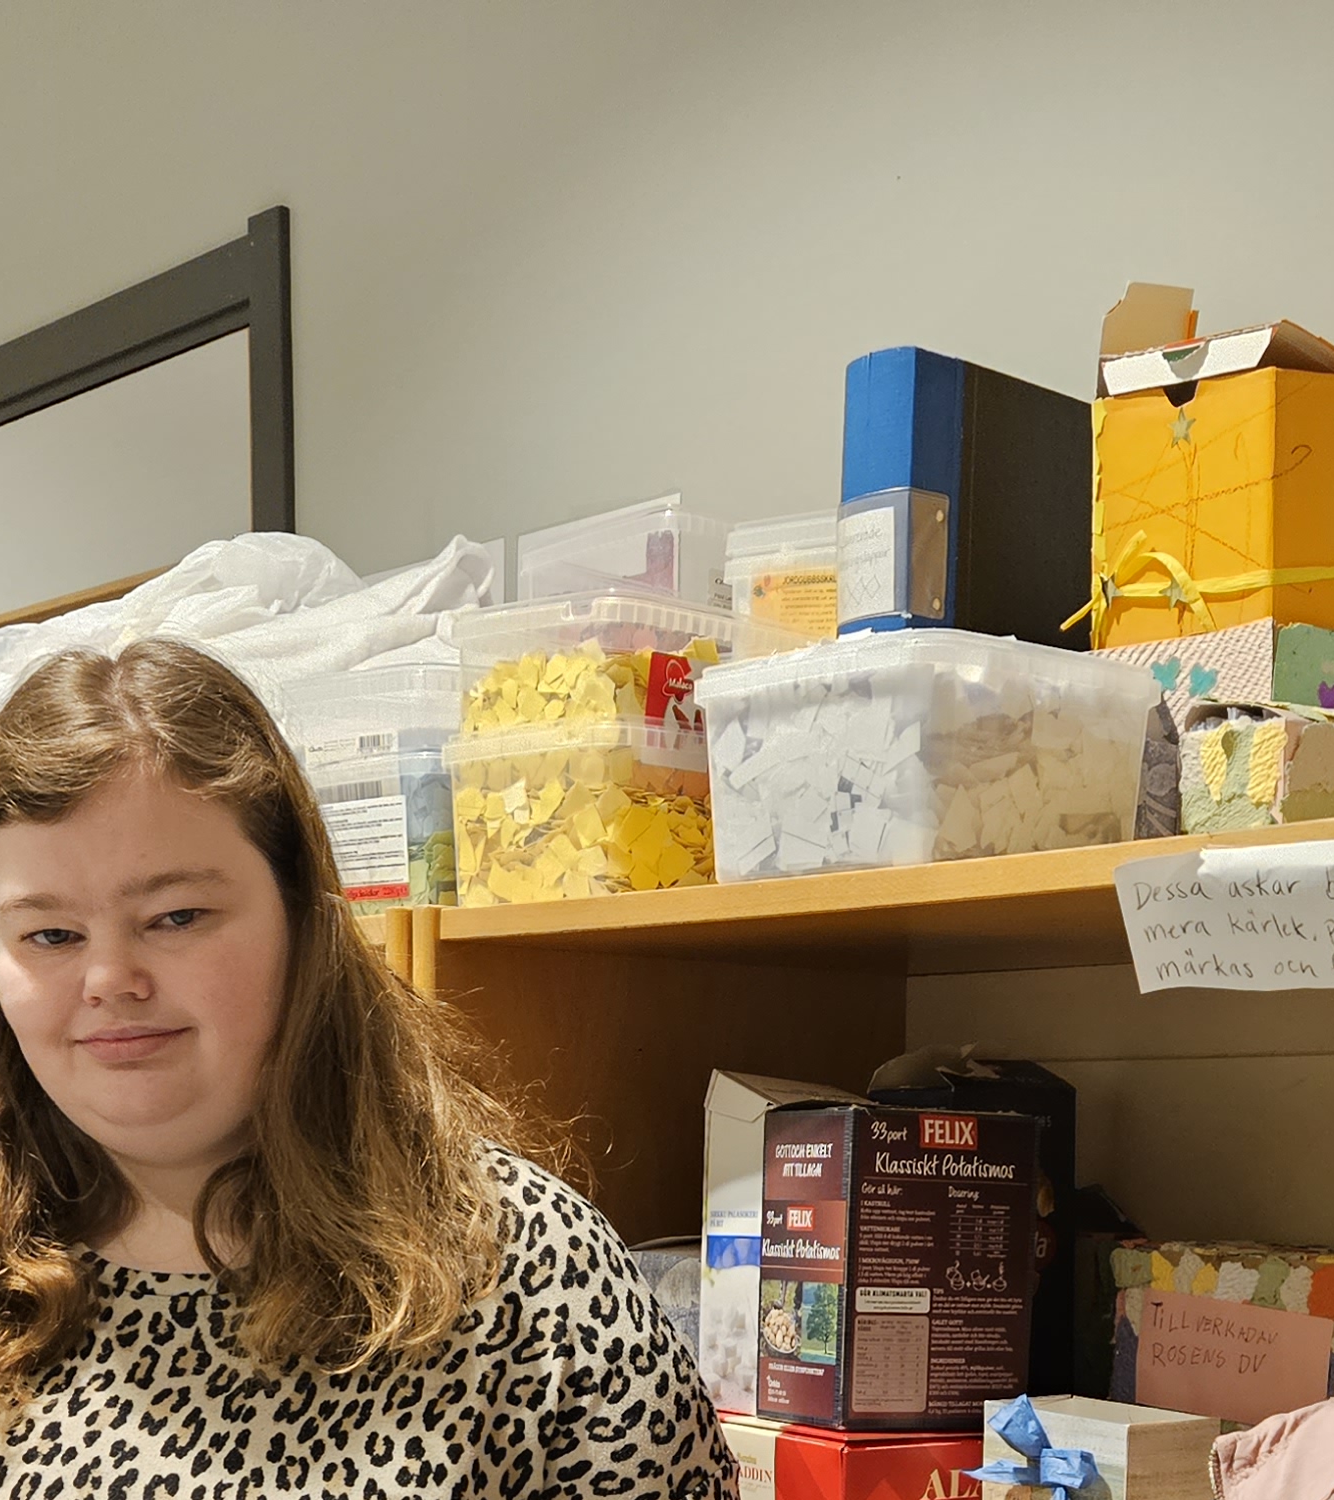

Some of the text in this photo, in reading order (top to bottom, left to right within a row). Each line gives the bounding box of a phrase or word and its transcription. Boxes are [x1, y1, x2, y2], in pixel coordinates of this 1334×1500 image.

[669, 677, 693, 690] Malaco
[1133, 879, 1212, 911] Dessa
[1228, 870, 1301, 898] askar
[1144, 921, 1211, 943] mera
[1156, 948, 1254, 981] märkas
[1274, 955, 1317, 977] och
[923, 1118, 975, 1146] FELIX
[874, 1151, 1017, 1179] Klassiskt Potatismos
[788, 1209, 813, 1228] FELIX
[762, 1238, 796, 1259] Klassiskt
[795, 1239, 841, 1260] Potatismos
[1152, 1341, 1227, 1370] ROSENS
[740, 1465, 773, 1484] DDIN
